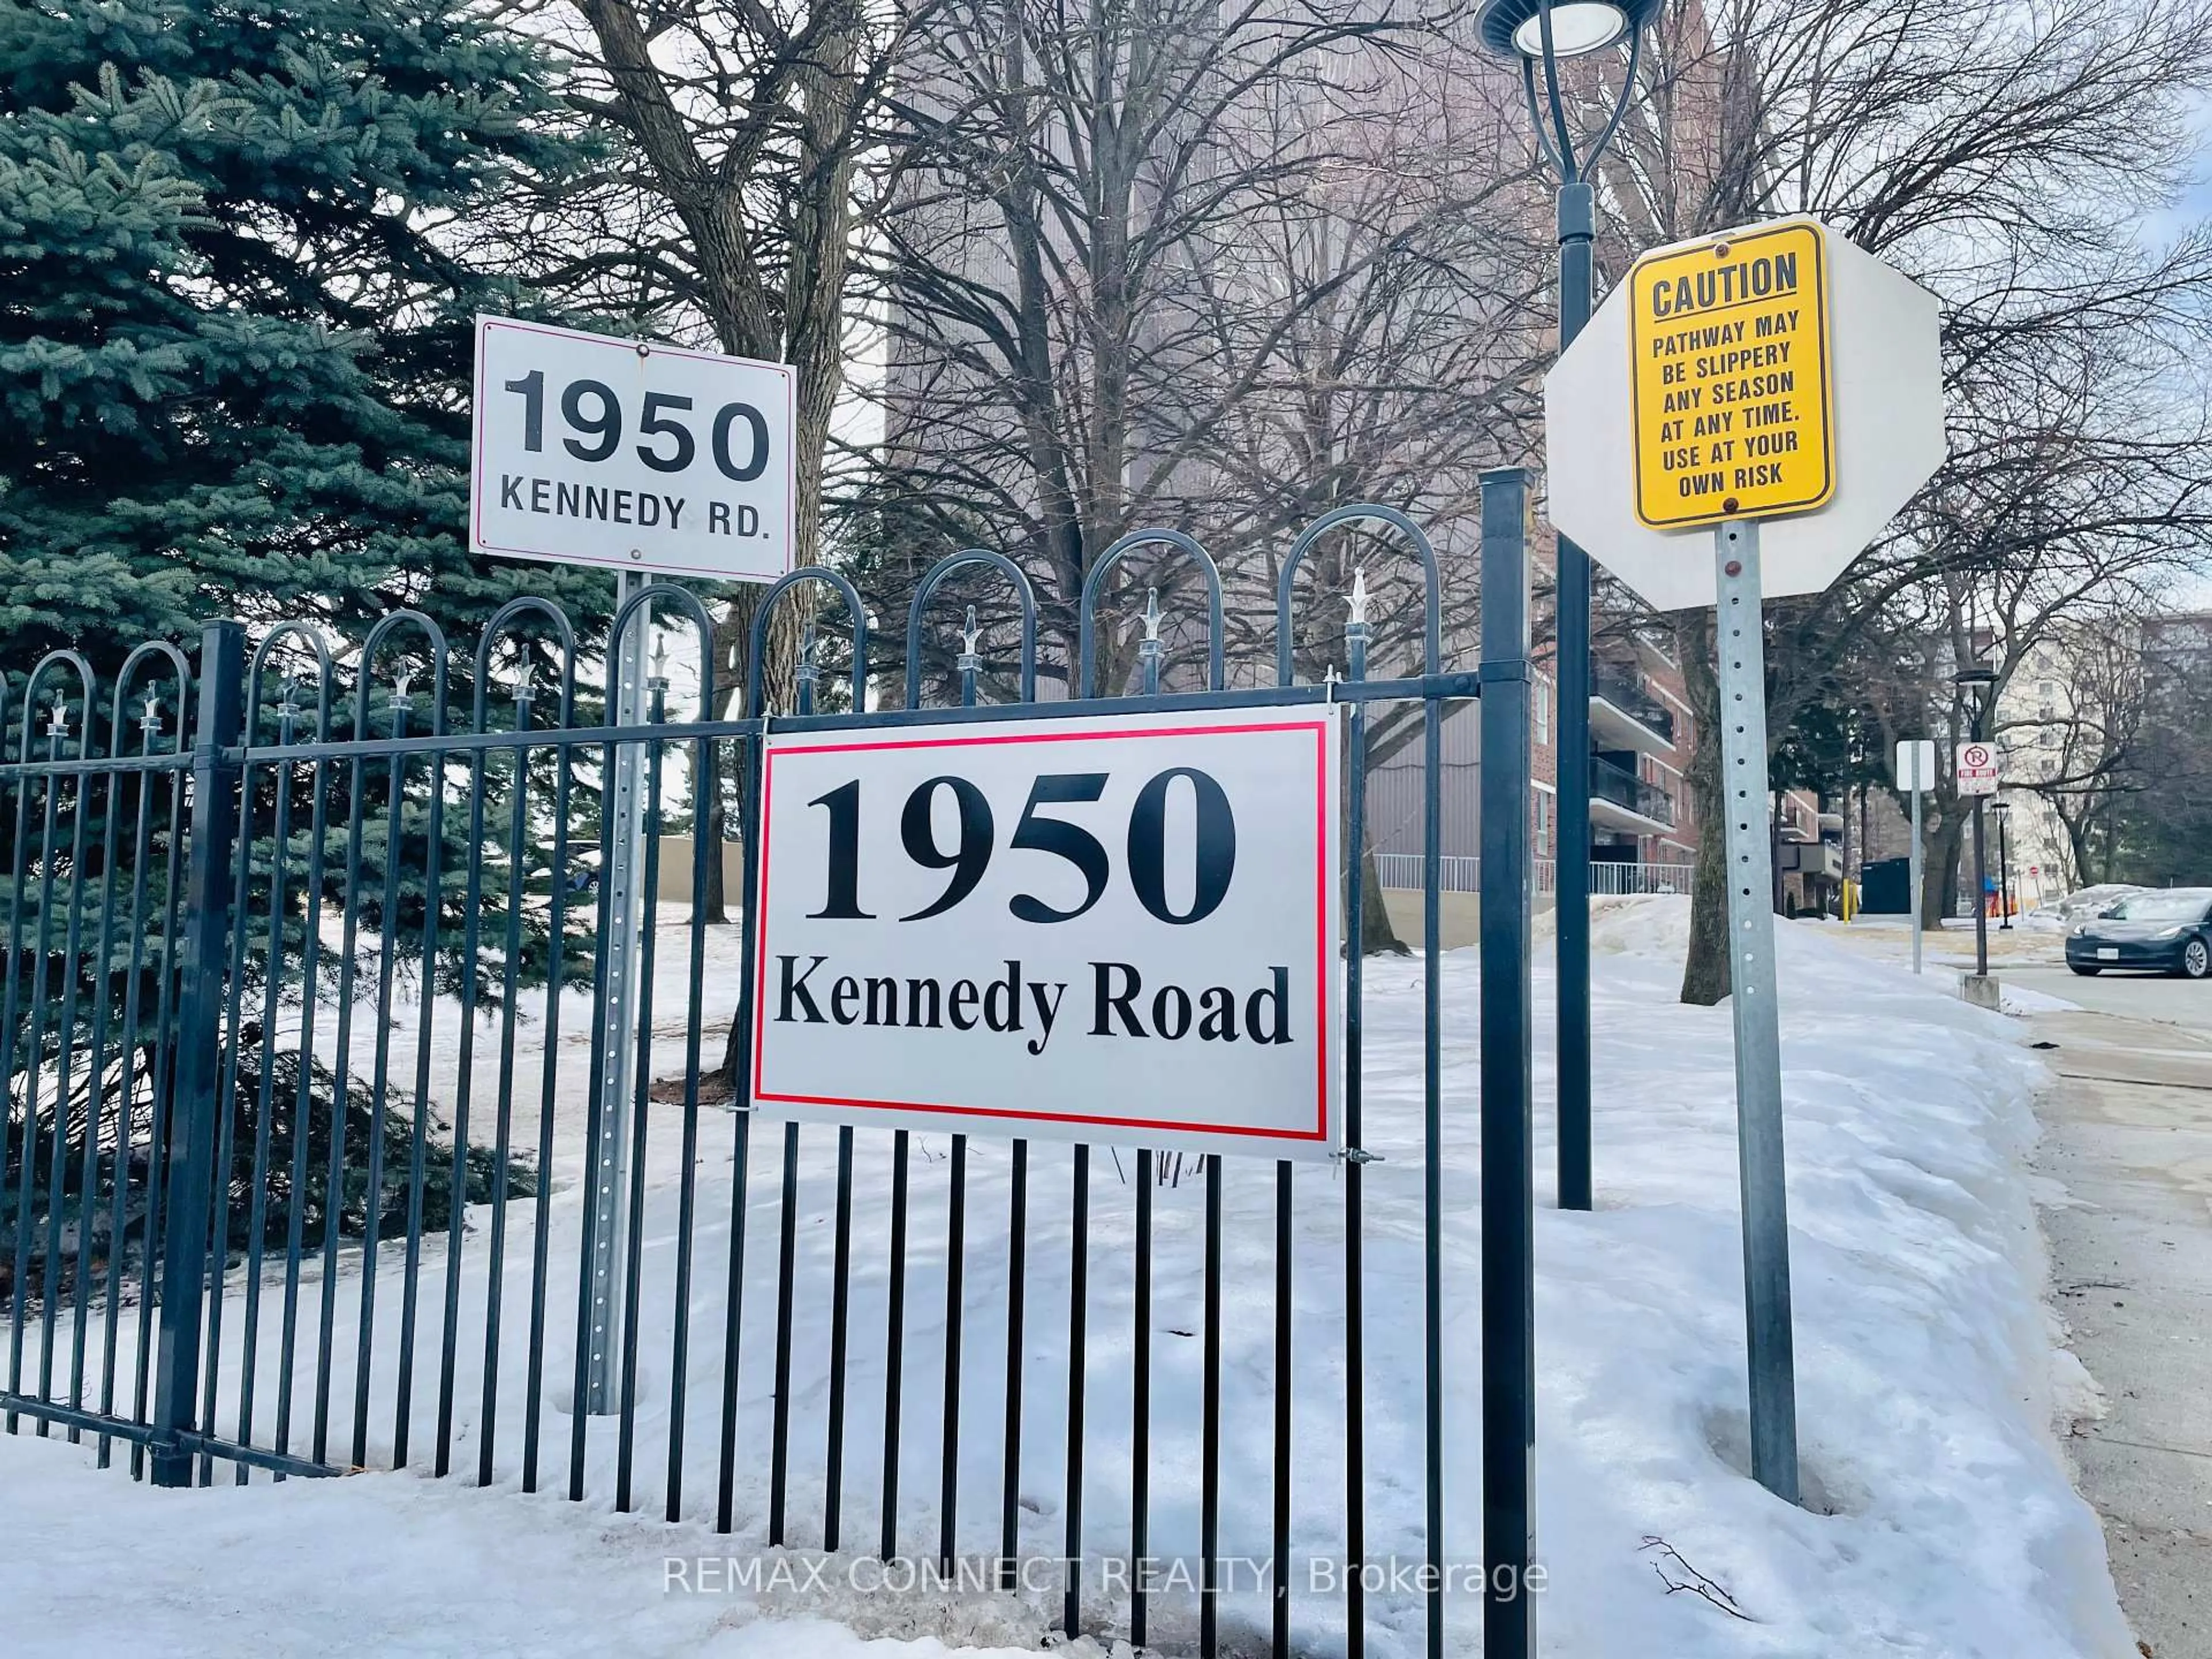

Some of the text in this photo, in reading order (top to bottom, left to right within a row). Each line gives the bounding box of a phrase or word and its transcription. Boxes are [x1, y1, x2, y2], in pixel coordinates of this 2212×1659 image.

[1653, 252, 1797, 316] CAUTION
[1653, 309, 1799, 358] PATHWAY MAY
[1664, 342, 1791, 385] BE SLIPPERY
[1664, 371, 1794, 414] ANY SEASON
[505, 369, 769, 482] 1950
[1661, 401, 1799, 442] AT ANY TIME.
[1664, 430, 1798, 471] USE AT YOUR
[1679, 463, 1783, 497] OWN RISK
[501, 474, 769, 539] KENNEDY RD.
[805, 767, 1236, 925] 1950
[774, 955, 1294, 1056] Kennedy Road
